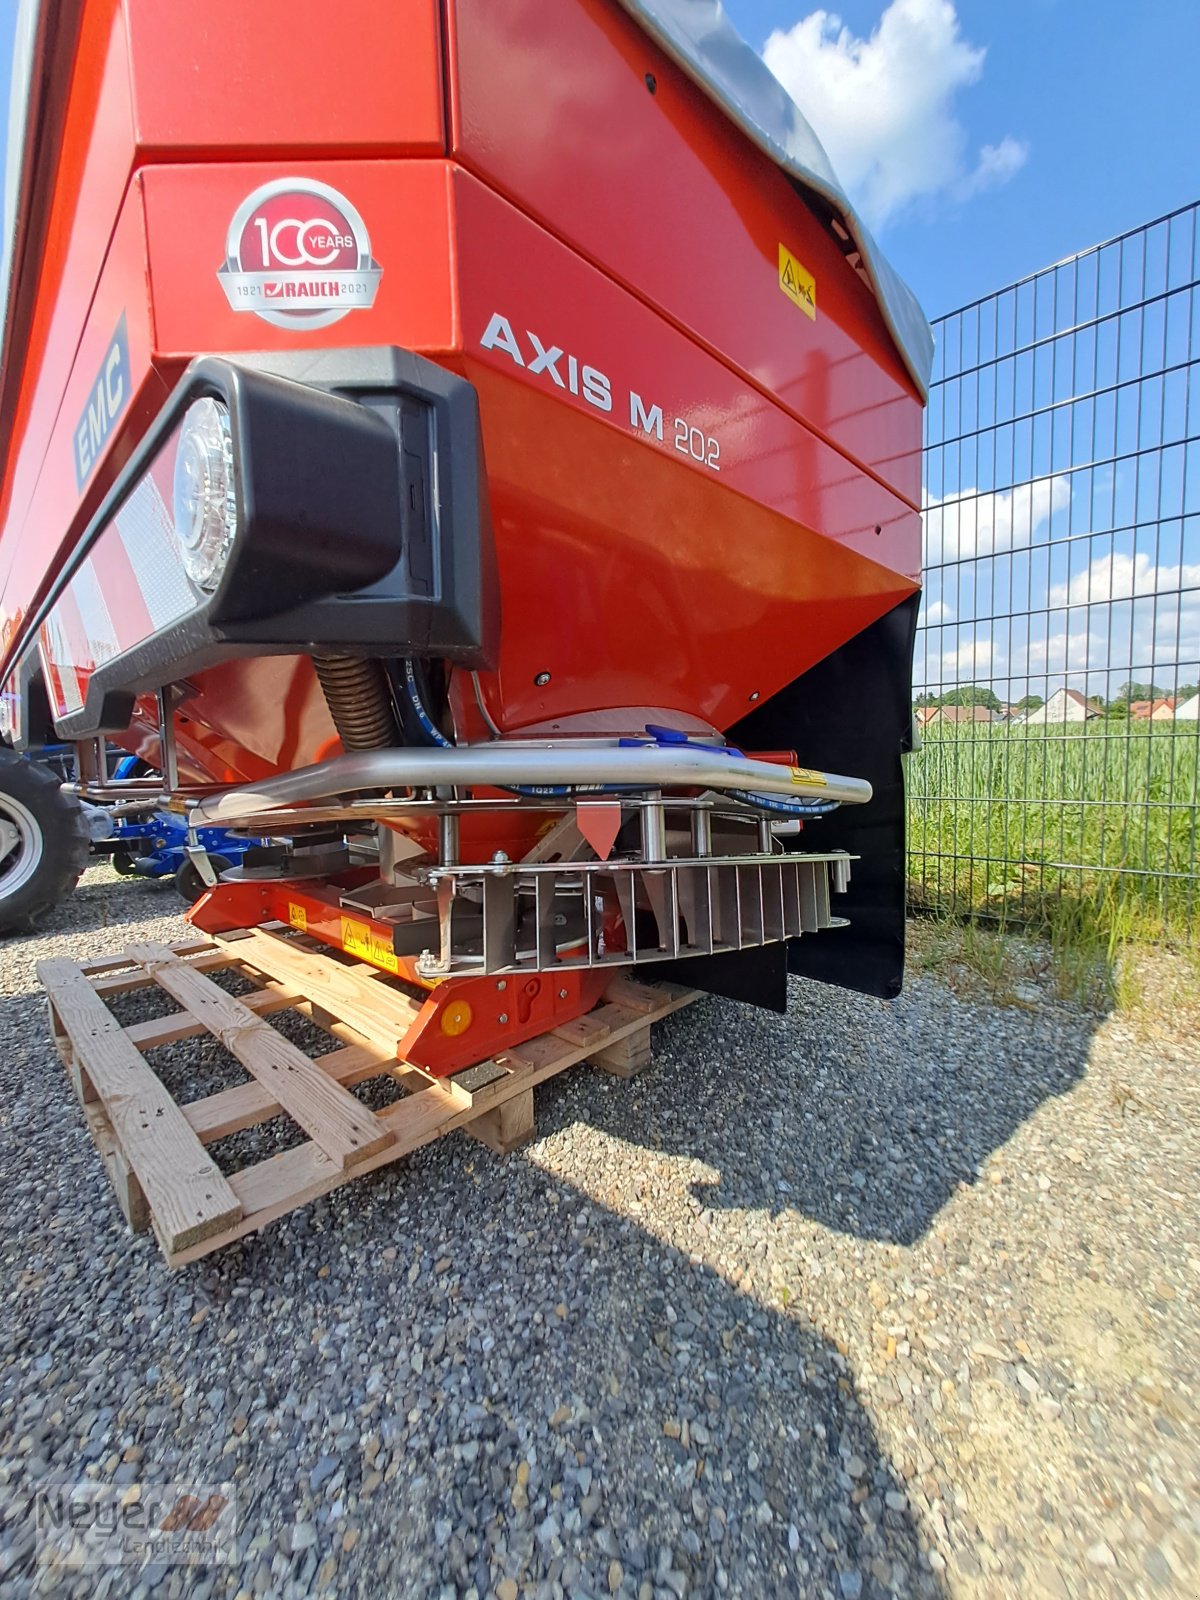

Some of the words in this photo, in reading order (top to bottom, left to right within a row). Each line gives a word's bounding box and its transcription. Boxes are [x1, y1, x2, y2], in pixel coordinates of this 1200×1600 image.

[254, 217, 341, 267] 100
[309, 235, 353, 249] YEARS
[237, 285, 262, 296] 1921
[284, 281, 340, 298] RAUCH
[341, 283, 368, 294] 2021
[77, 343, 123, 479] EMC
[480, 312, 613, 412] AXIS
[629, 390, 664, 441] M
[674, 417, 721, 471] 20.2
